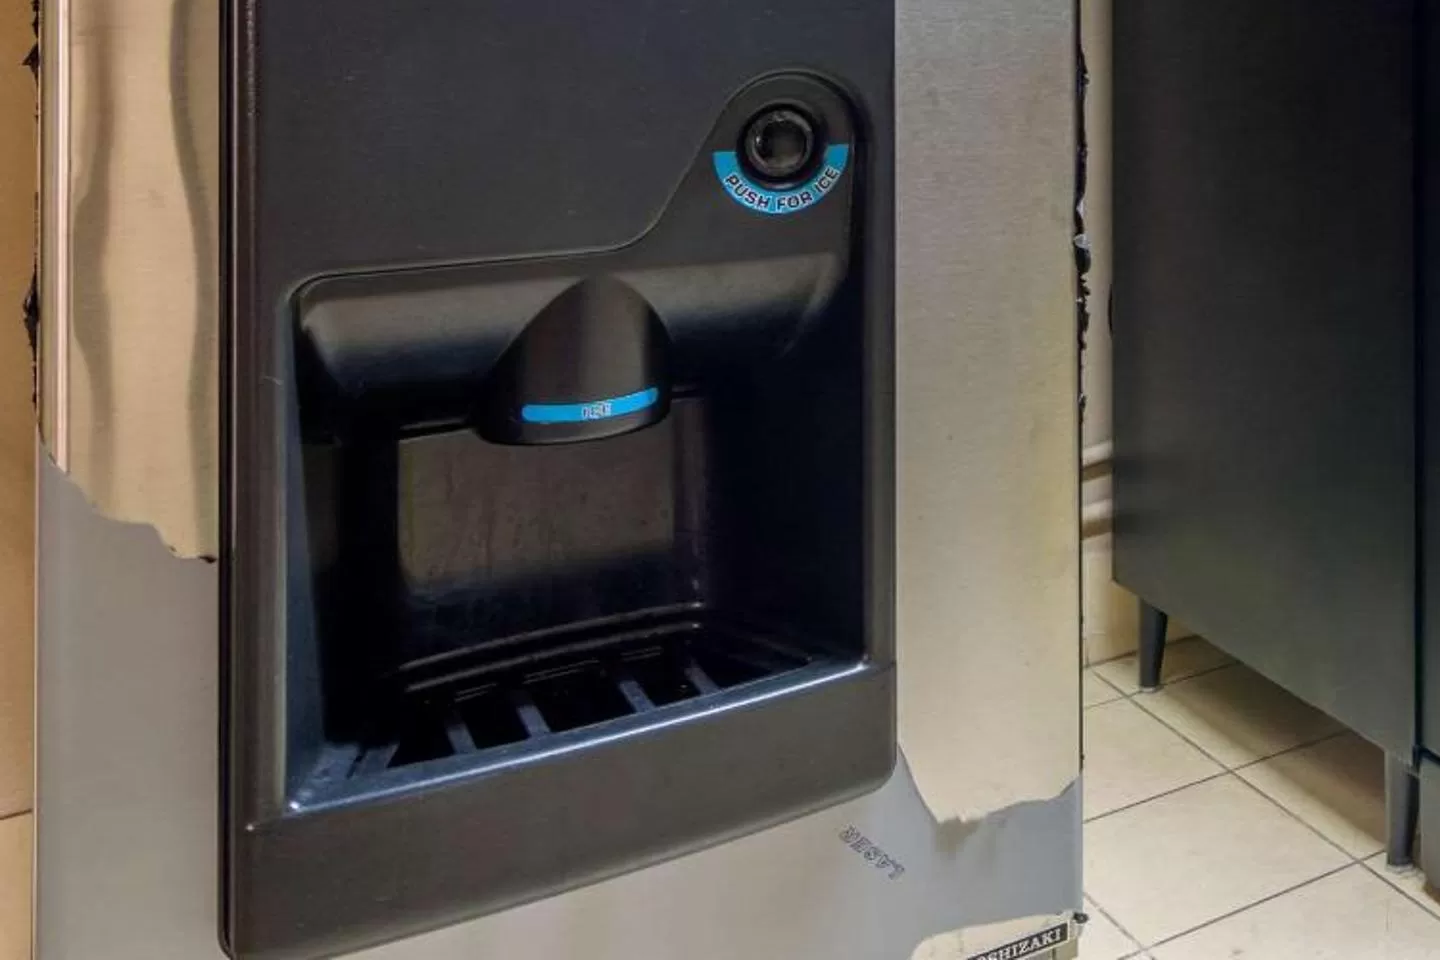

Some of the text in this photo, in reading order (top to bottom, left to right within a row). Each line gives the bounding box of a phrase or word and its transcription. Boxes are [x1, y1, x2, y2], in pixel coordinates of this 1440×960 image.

[724, 167, 839, 210] PUSH FOR ICE
